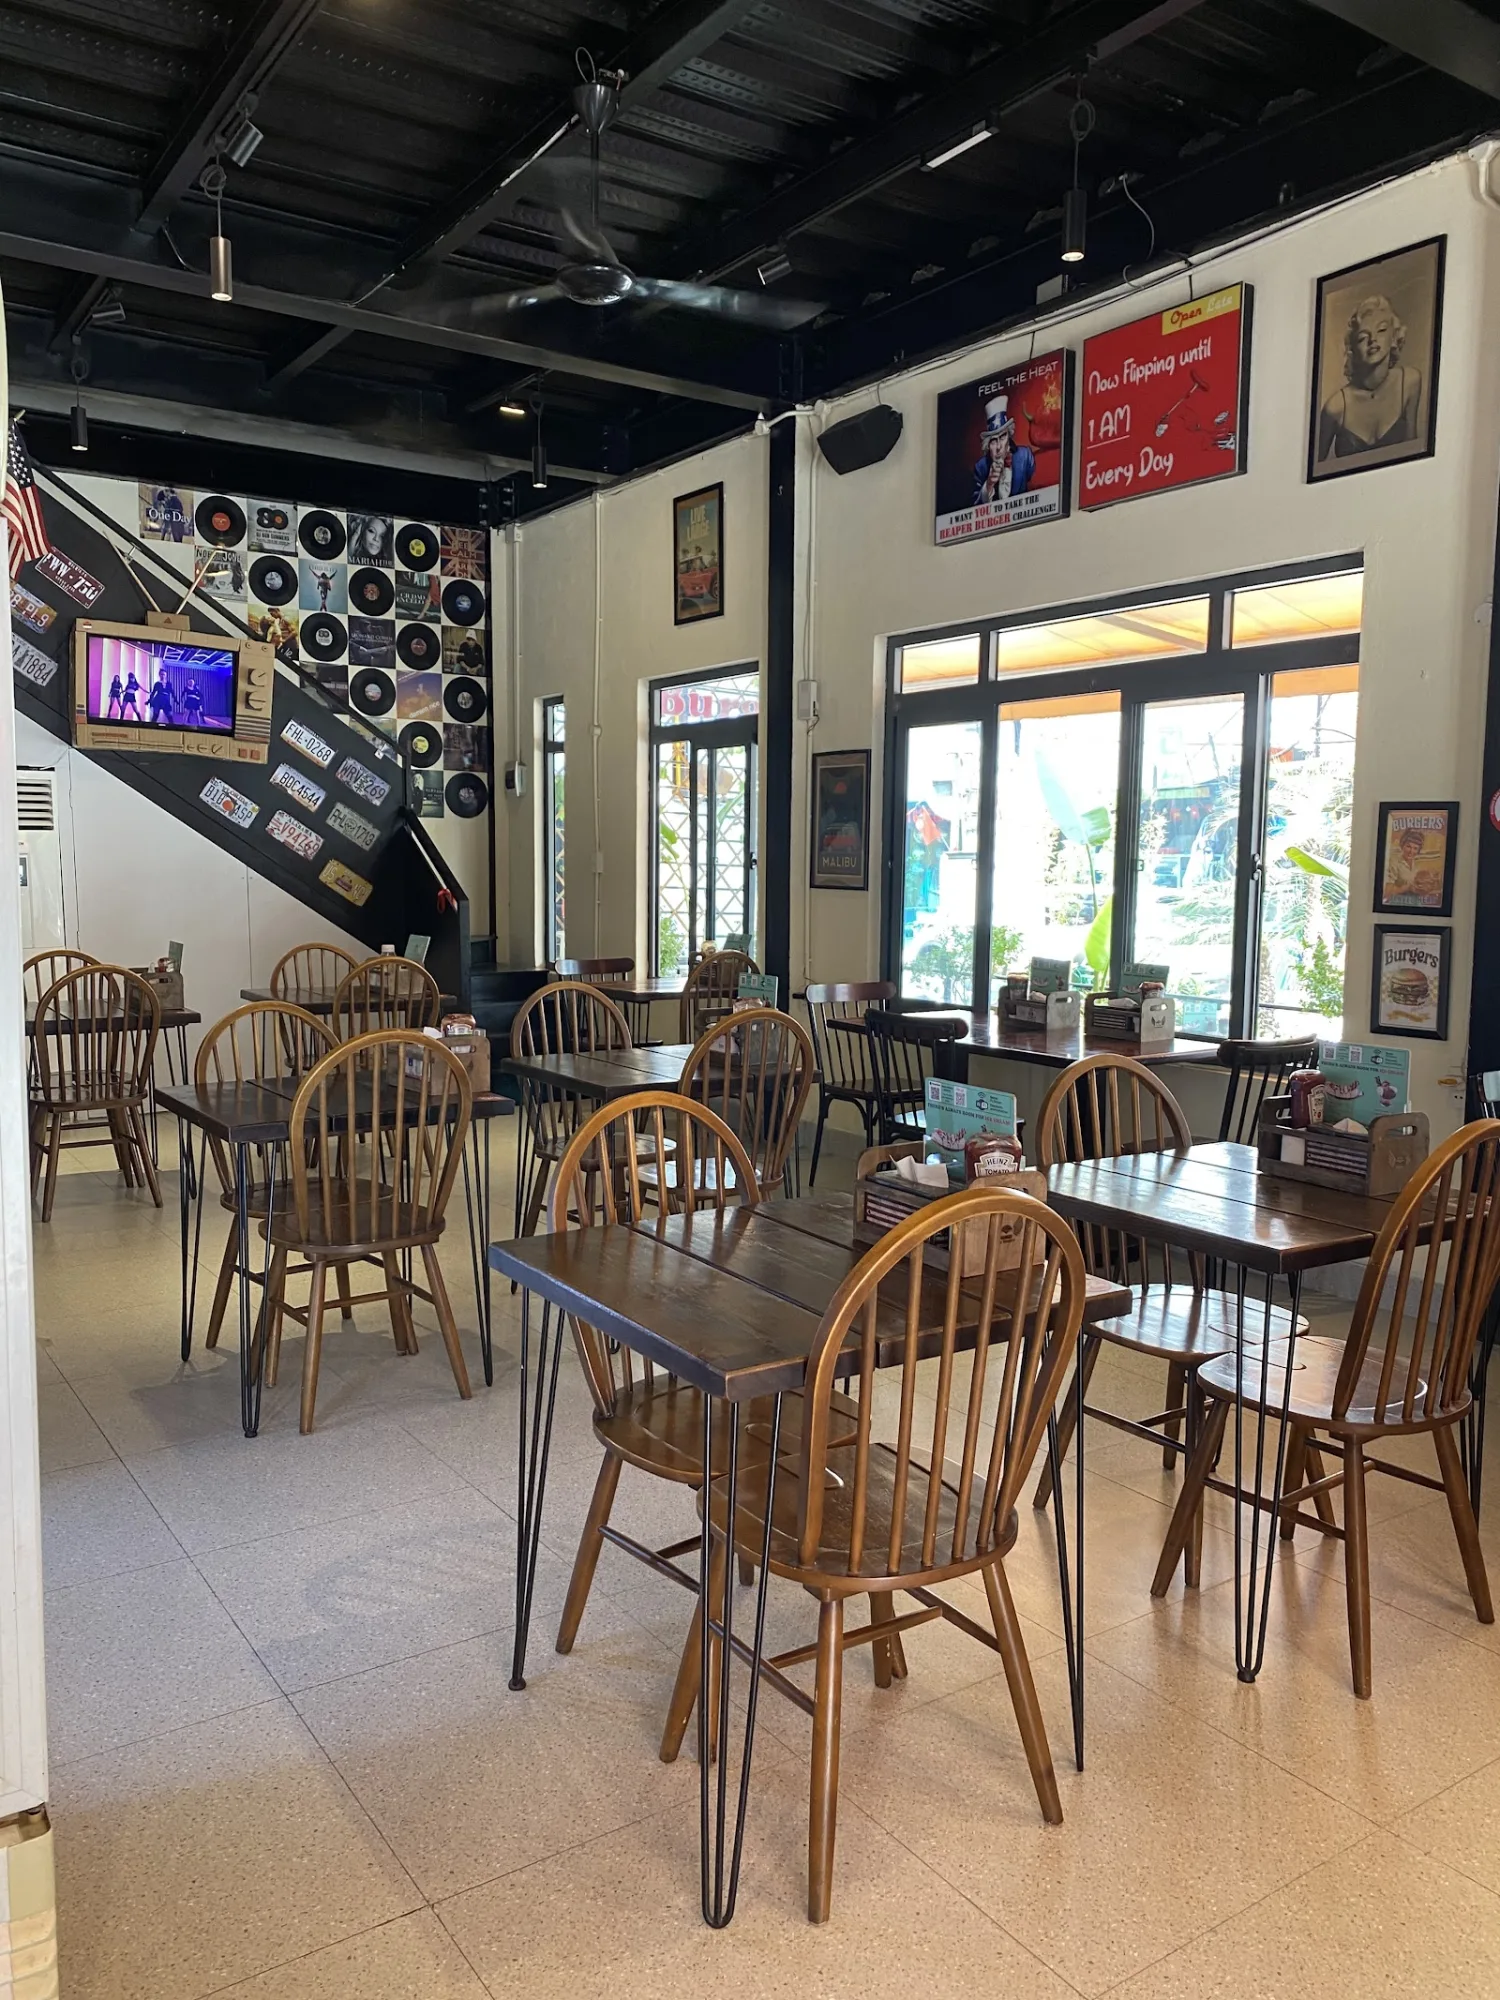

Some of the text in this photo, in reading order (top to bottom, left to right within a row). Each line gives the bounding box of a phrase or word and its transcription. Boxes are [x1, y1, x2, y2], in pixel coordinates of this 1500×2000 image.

[1170, 295, 1233, 328] Open Late
[978, 360, 1059, 397] FEEL THE HEAT
[1088, 336, 1212, 396] Now Flipping until
[1098, 404, 1131, 439] AM
[1085, 446, 1174, 490] Every Day
[148, 507, 192, 525] One Day
[939, 503, 1057, 540] REAPER BURGER CHALLENGE!
[954, 511, 973, 523] WANT
[975, 505, 992, 518] YOU
[993, 503, 1003, 513] TO
[1004, 499, 1024, 511] TAKE
[1024, 494, 1040, 505] THE
[365, 780, 387, 800] 269
[1392, 816, 1444, 832] BURGERS
[822, 856, 857, 868] MALIBU
[1384, 947, 1439, 968] Burgers
[986, 1158, 1009, 1166] HEINZ
